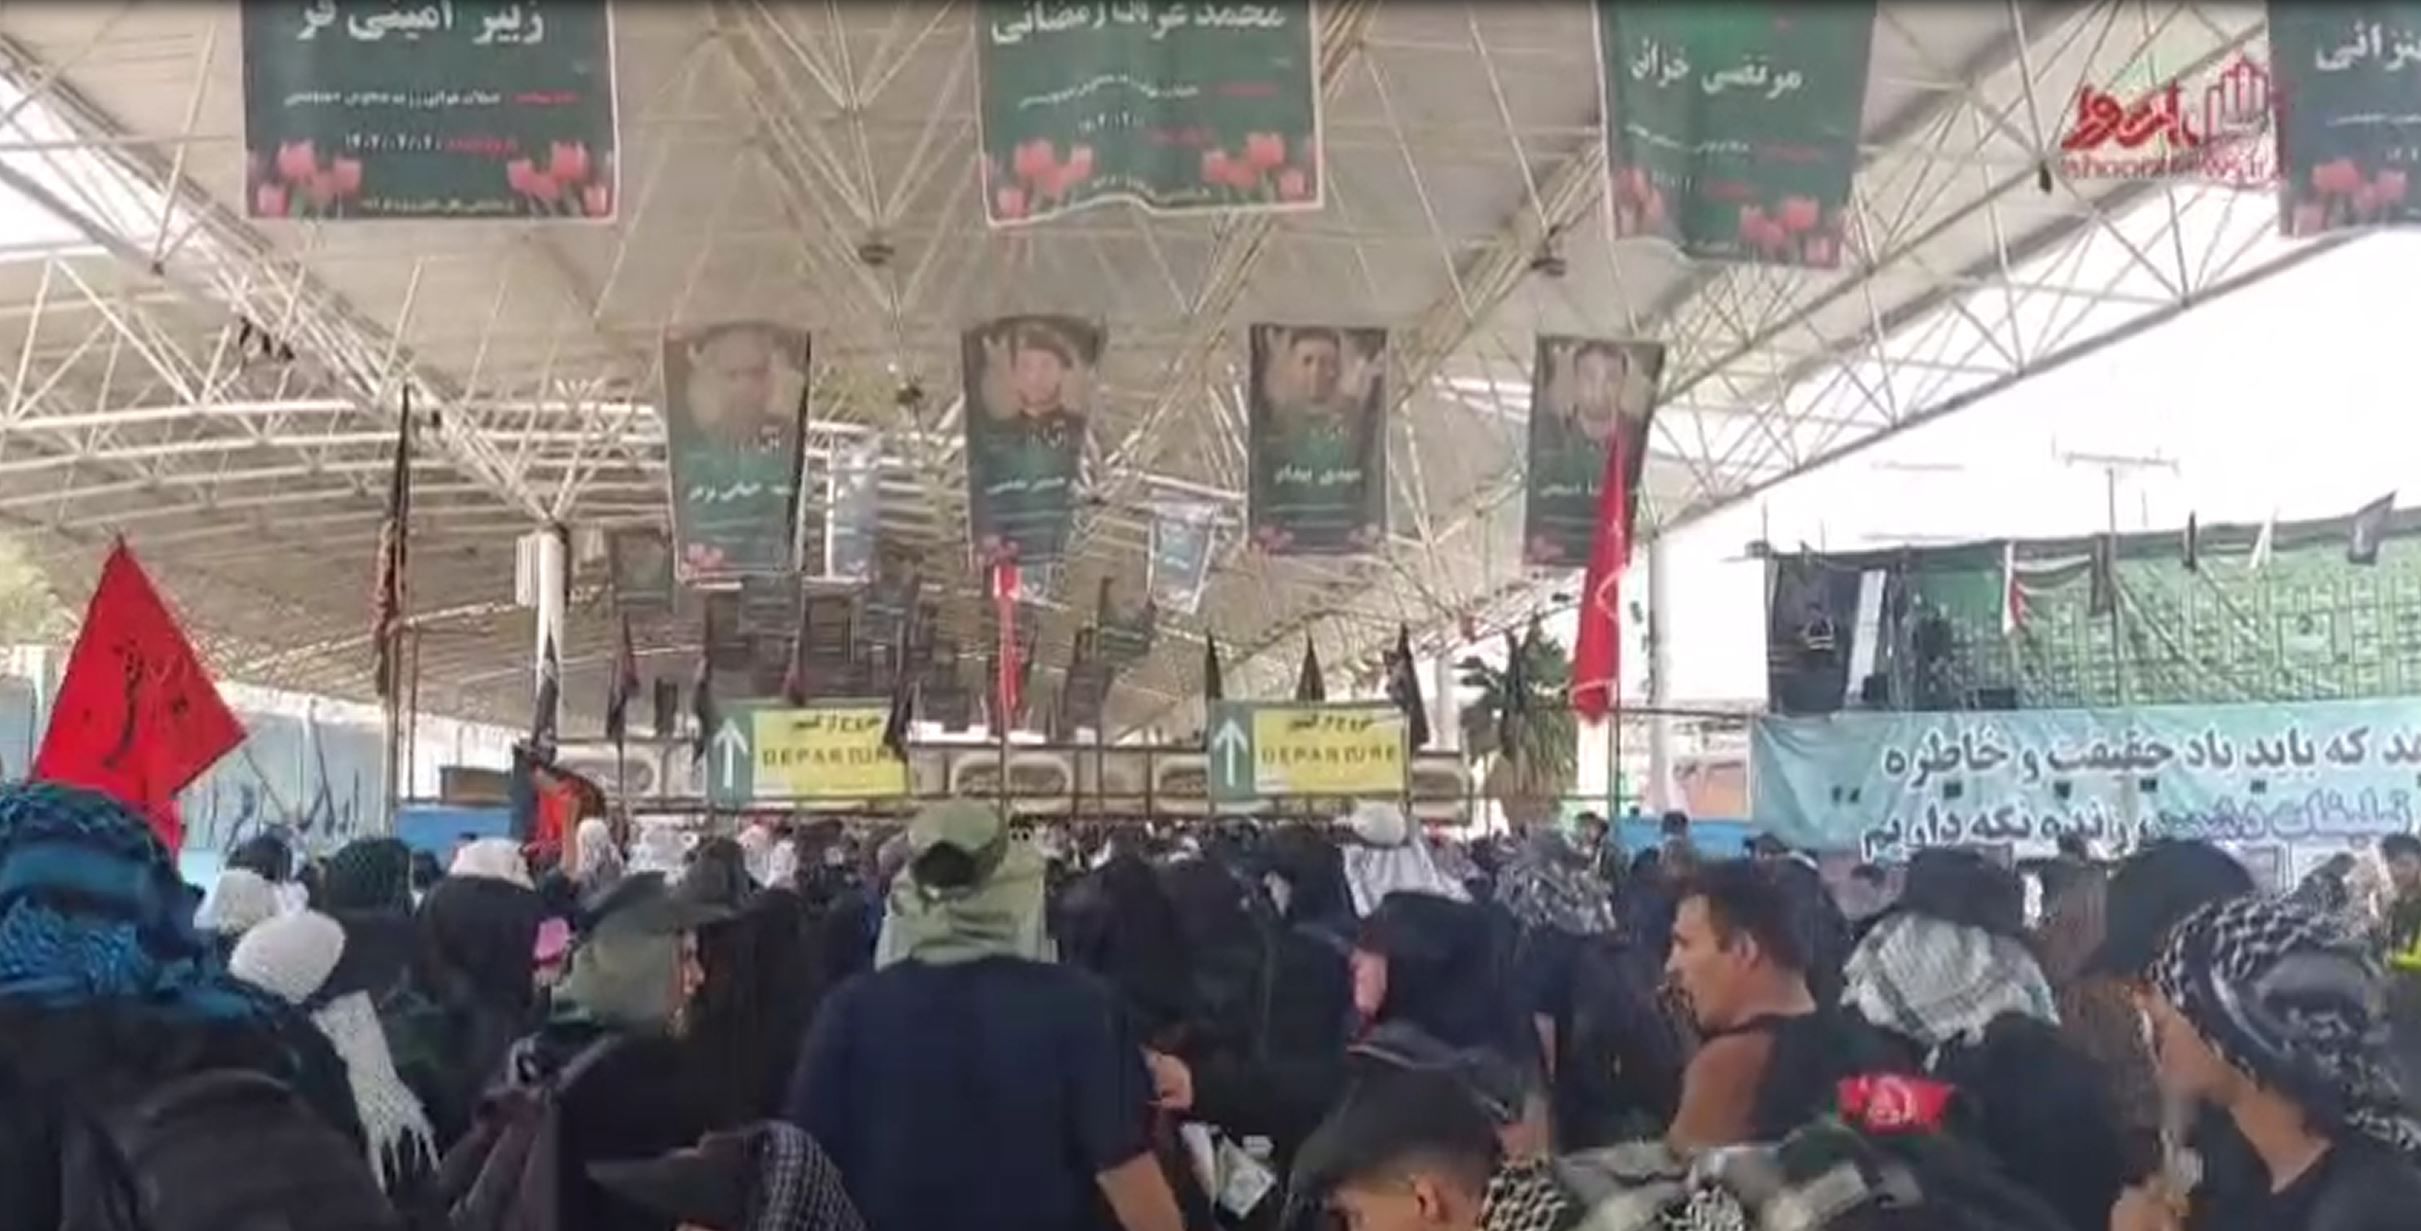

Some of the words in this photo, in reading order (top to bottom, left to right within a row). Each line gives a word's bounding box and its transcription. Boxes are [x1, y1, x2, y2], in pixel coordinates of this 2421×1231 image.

[763, 746, 898, 767] DEPARTUR
[1261, 746, 1397, 766] DEPARTURE
[1884, 728, 2010, 789] خاطره
[2245, 727, 2316, 778] باید
[2325, 725, 2369, 764] که
[2021, 748, 2041, 784] و
